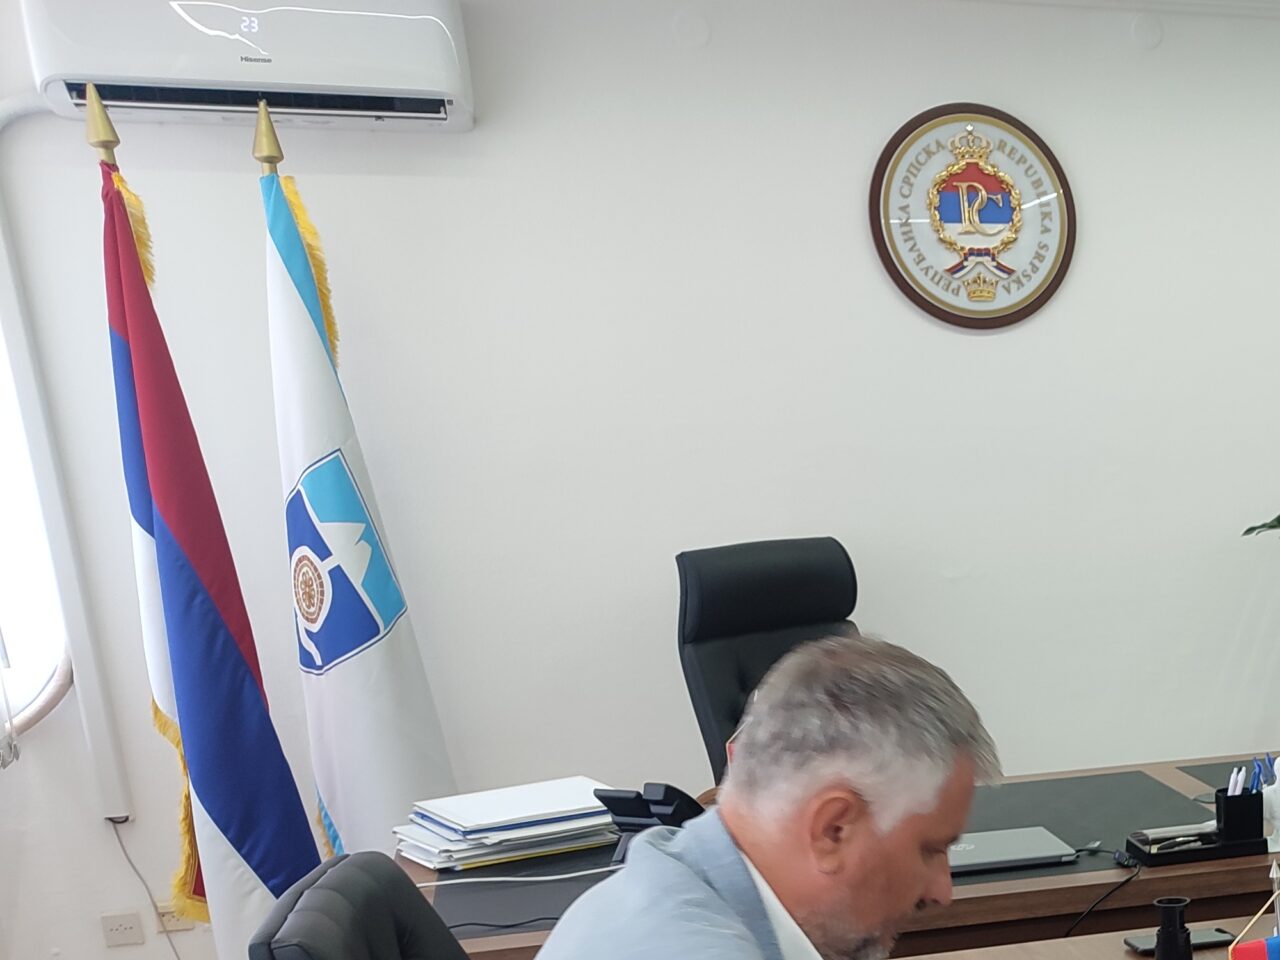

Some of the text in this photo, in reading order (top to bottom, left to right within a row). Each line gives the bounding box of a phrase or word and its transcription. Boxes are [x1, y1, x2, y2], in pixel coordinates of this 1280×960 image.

[240, 16, 259, 32] 23
[898, 138, 962, 297] РЕПУБЛИКА СРПСКА
[1001, 241, 1050, 296] SRPSKA
